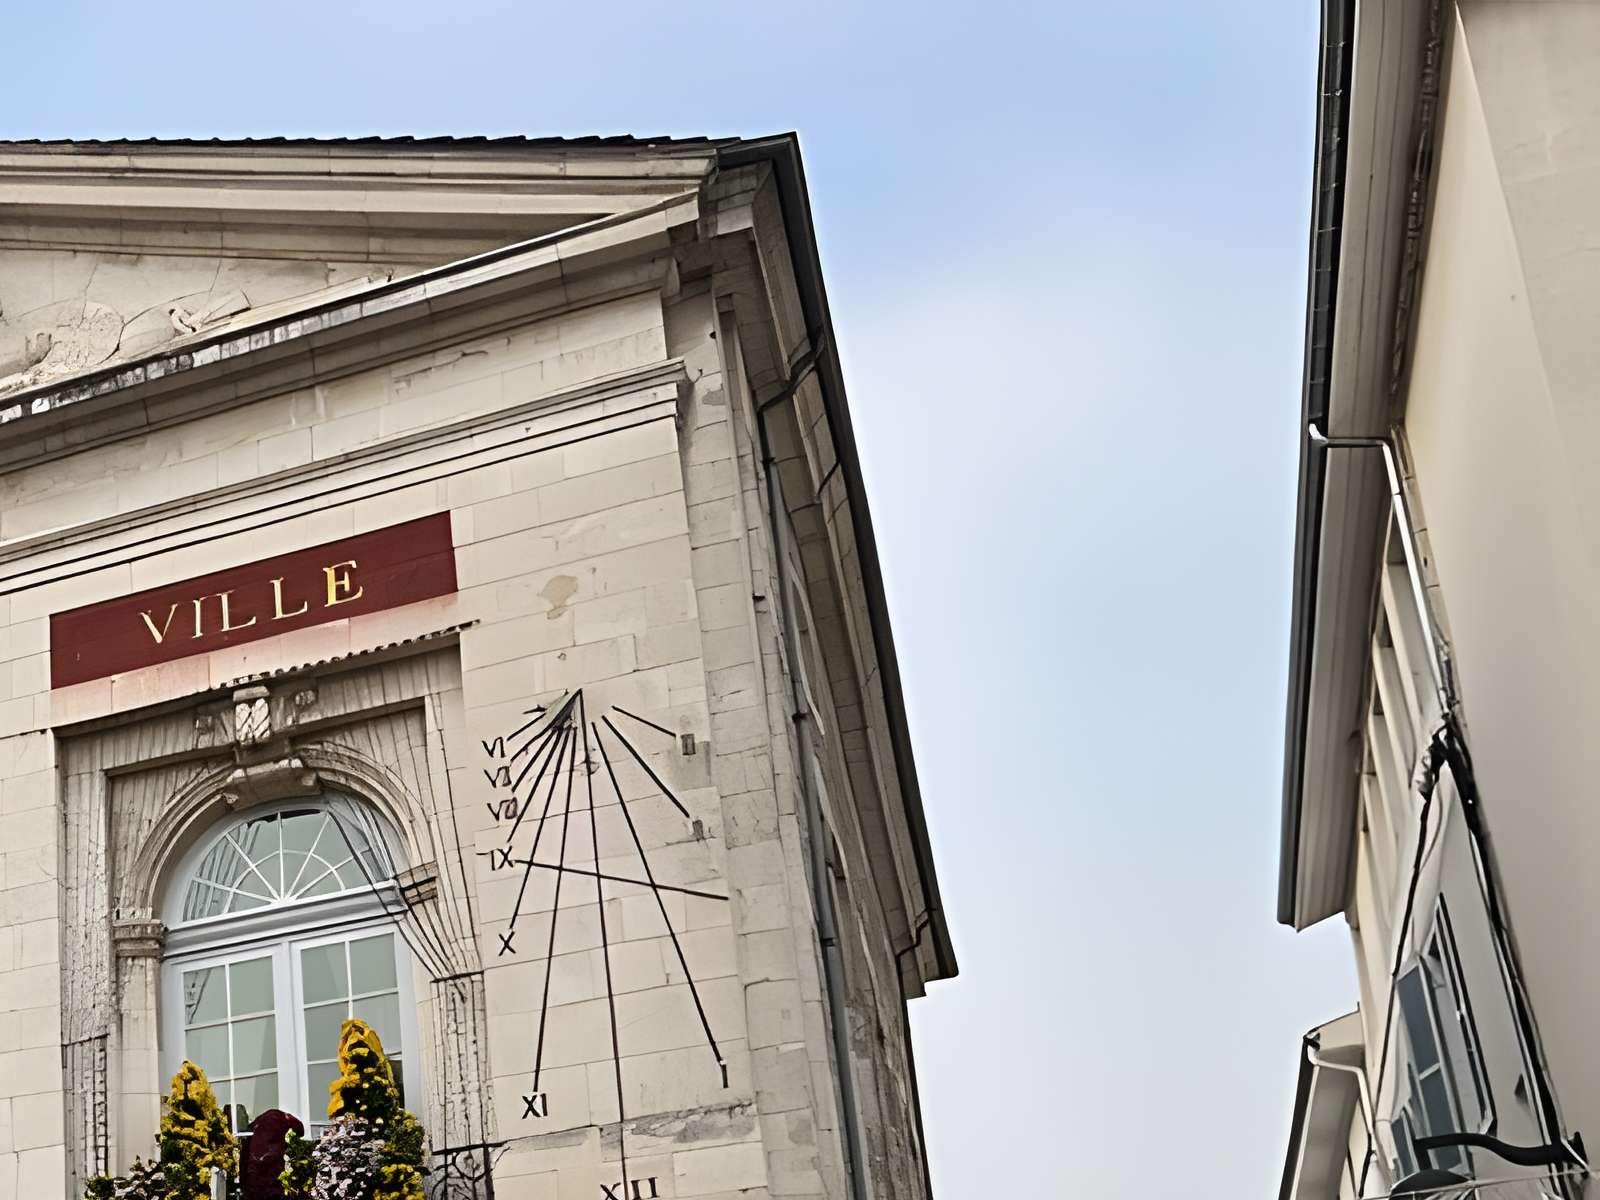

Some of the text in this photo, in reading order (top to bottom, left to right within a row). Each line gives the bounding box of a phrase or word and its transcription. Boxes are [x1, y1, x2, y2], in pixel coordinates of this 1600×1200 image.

[139, 559, 364, 645] VILLE
[498, 931, 517, 957] X
[521, 1092, 549, 1120] XI
